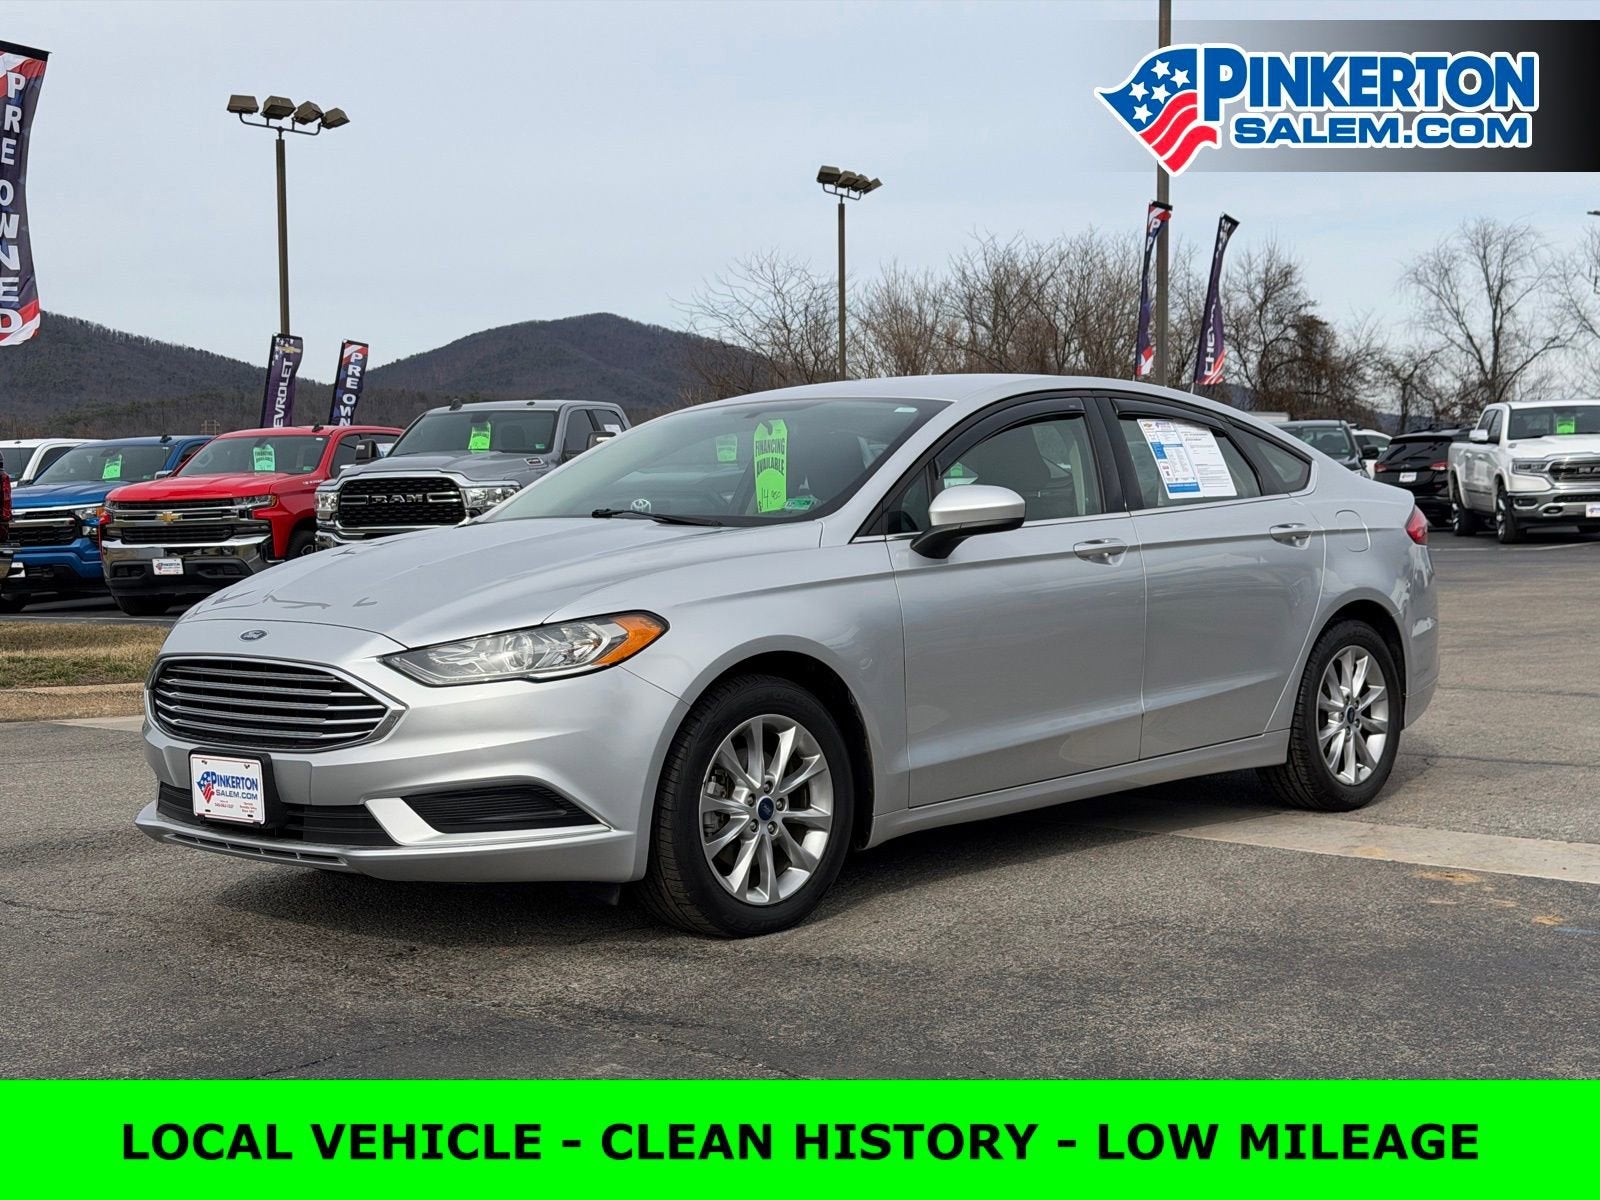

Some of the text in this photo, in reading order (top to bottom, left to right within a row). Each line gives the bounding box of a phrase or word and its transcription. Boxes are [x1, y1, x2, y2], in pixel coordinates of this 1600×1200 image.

[1, 71, 26, 166] PRE
[273, 357, 294, 428] EVROLET
[339, 352, 364, 427] PRE OWN
[371, 494, 423, 504] RAM
[211, 771, 259, 791] PINKERTON
[216, 789, 258, 800] SALEM.COM
